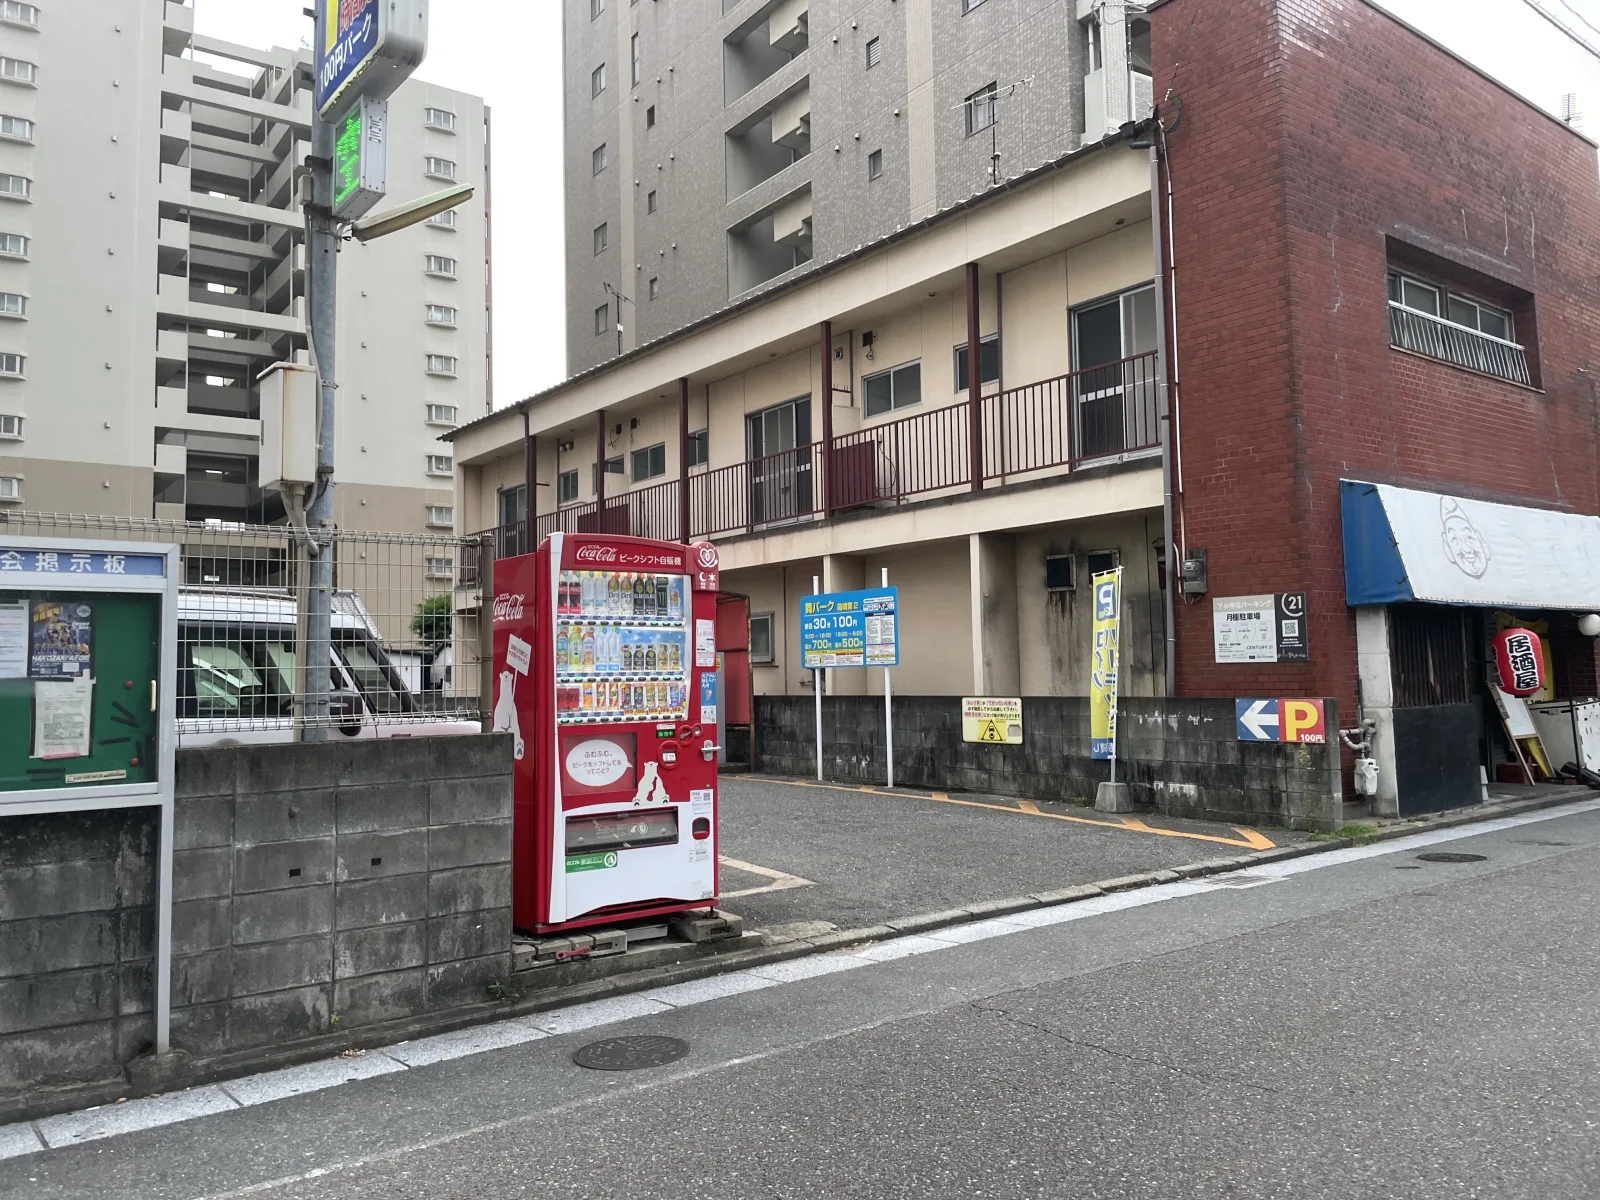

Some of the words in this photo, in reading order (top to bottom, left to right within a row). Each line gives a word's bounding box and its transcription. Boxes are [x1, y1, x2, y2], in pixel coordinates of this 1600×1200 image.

[319, 13, 372, 92] 100円パーク
[619, 553, 682, 566] ピークシフト自販機
[833, 615, 858, 628] 100円
[1226, 612, 1261, 621] 月極駐車場
[1505, 634, 1539, 690] 居酒屋
[1285, 701, 1319, 741] P
